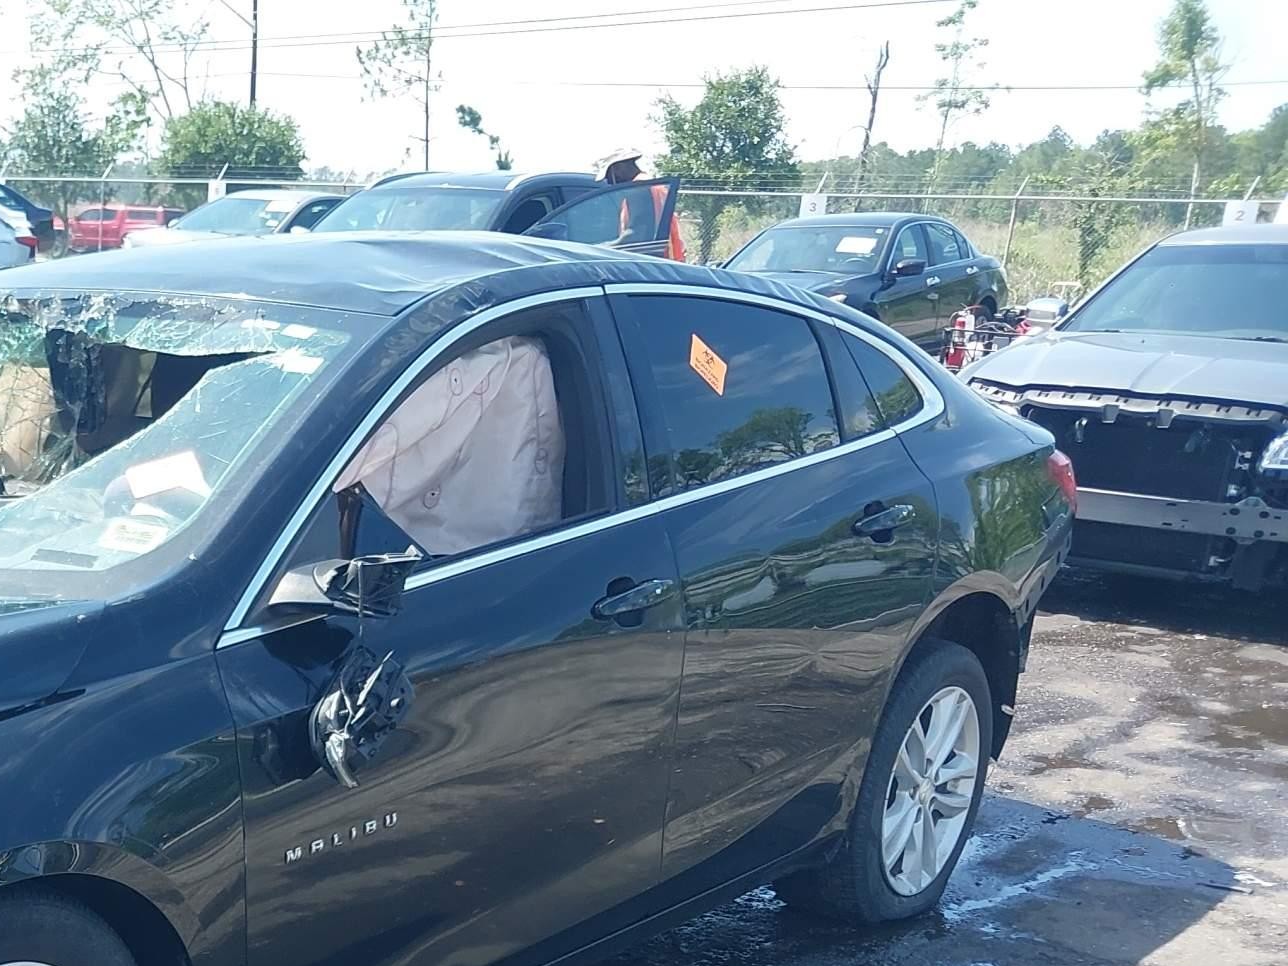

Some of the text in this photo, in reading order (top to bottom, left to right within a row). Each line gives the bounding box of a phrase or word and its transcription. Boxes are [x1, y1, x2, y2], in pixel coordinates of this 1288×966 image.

[809, 202, 817, 212] 3
[1234, 209, 1245, 221] 2
[285, 812, 399, 866] MALIBU
